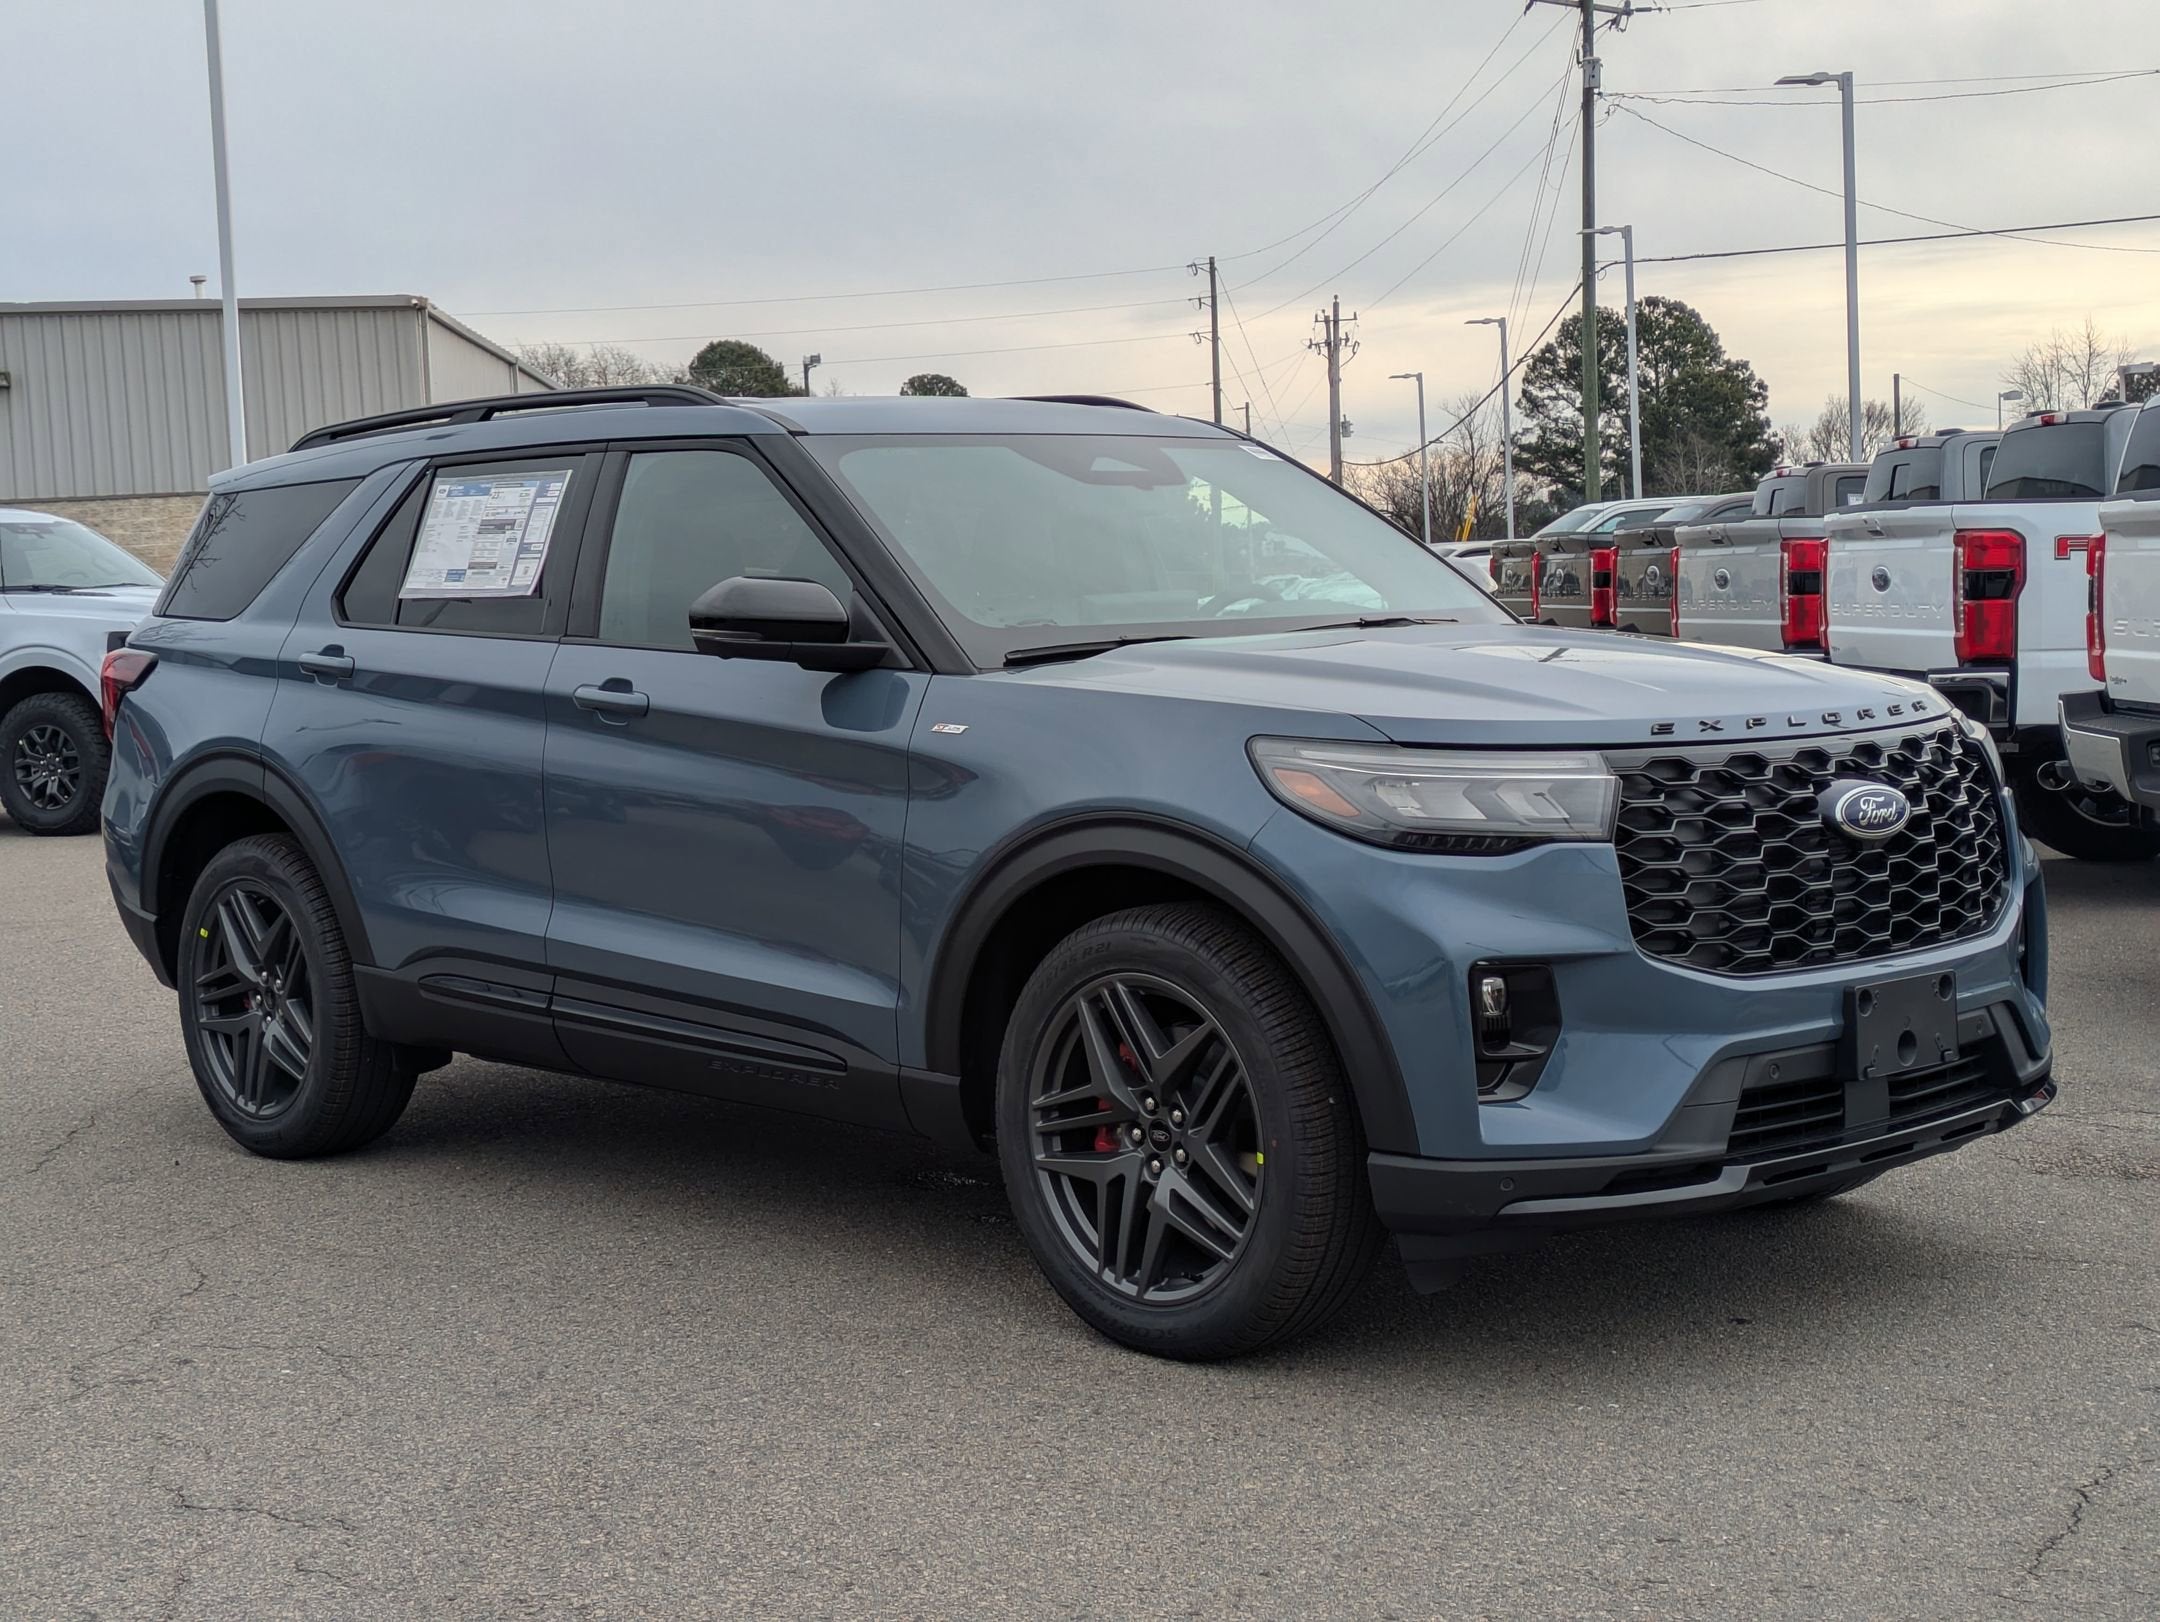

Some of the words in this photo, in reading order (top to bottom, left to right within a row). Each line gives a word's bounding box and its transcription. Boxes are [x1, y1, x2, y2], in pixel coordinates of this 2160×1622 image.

[1831, 602, 1887, 617] SUPER
[1889, 603, 1945, 619] DUTY
[1650, 699, 1929, 736] EXPLORER
[1858, 796, 1897, 826] Ford
